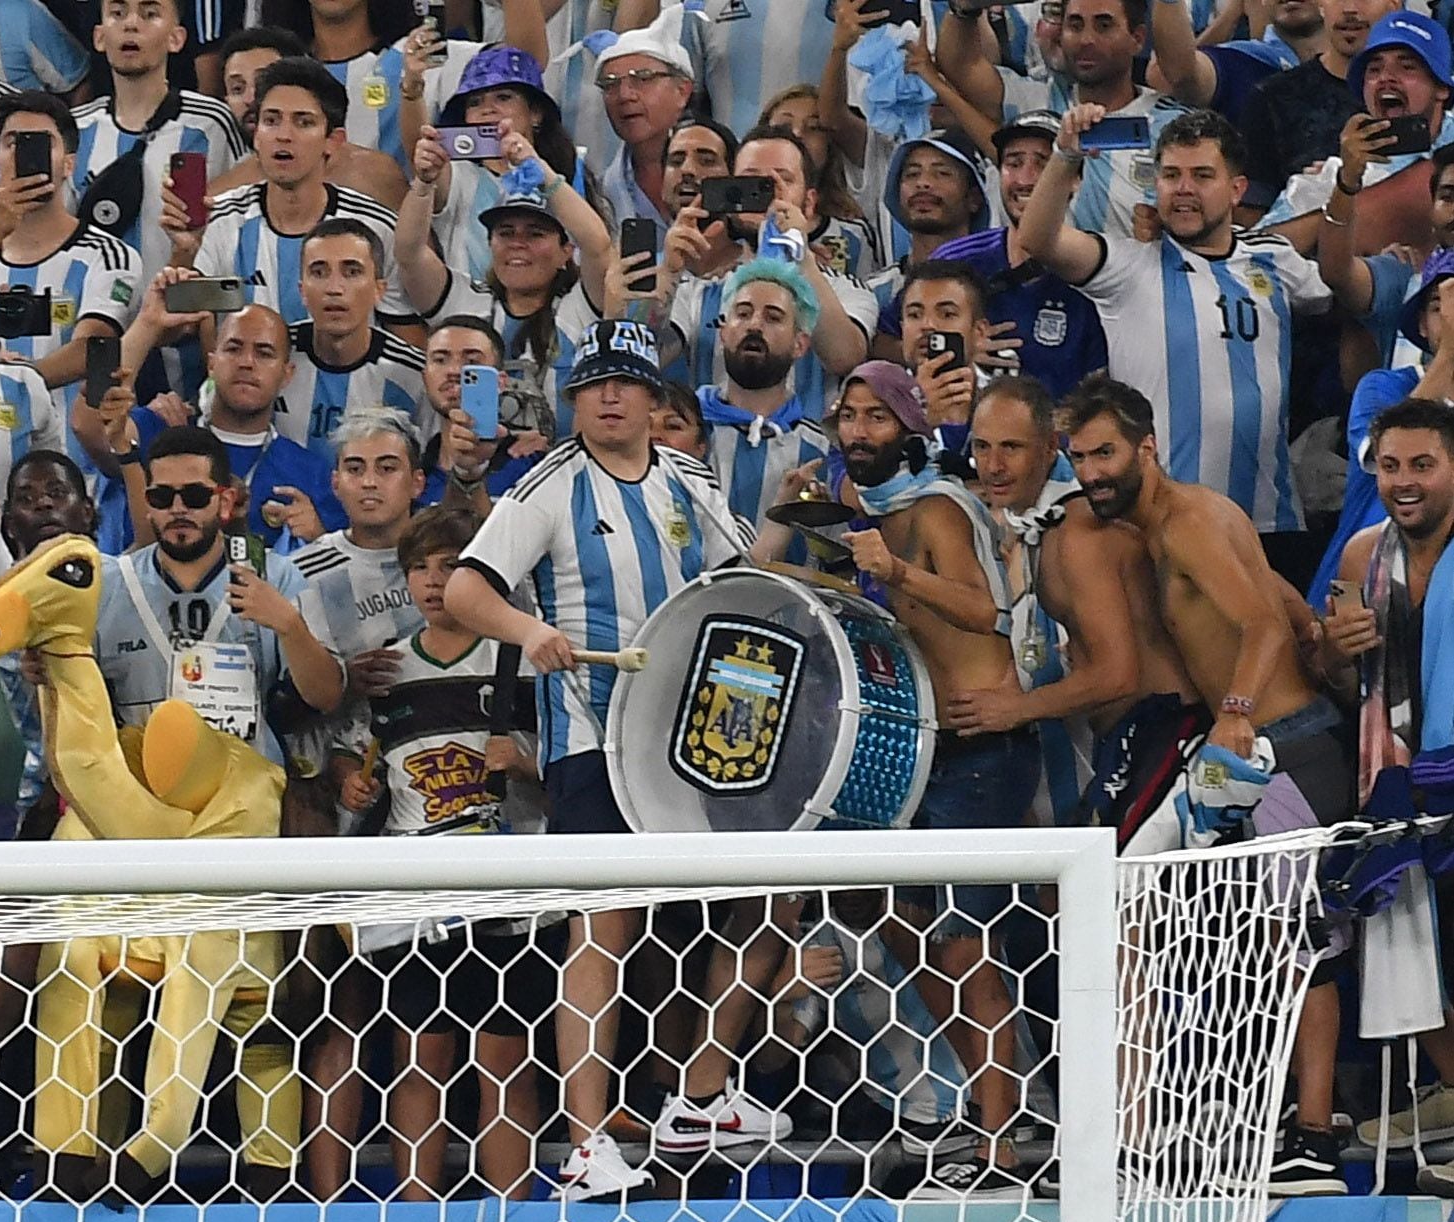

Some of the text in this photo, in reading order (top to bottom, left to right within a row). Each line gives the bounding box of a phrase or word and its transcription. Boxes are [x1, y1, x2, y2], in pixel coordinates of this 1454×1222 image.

[1214, 294, 1260, 342] 10
[357, 588, 414, 621] JUGADO
[117, 638, 148, 655] FILA
